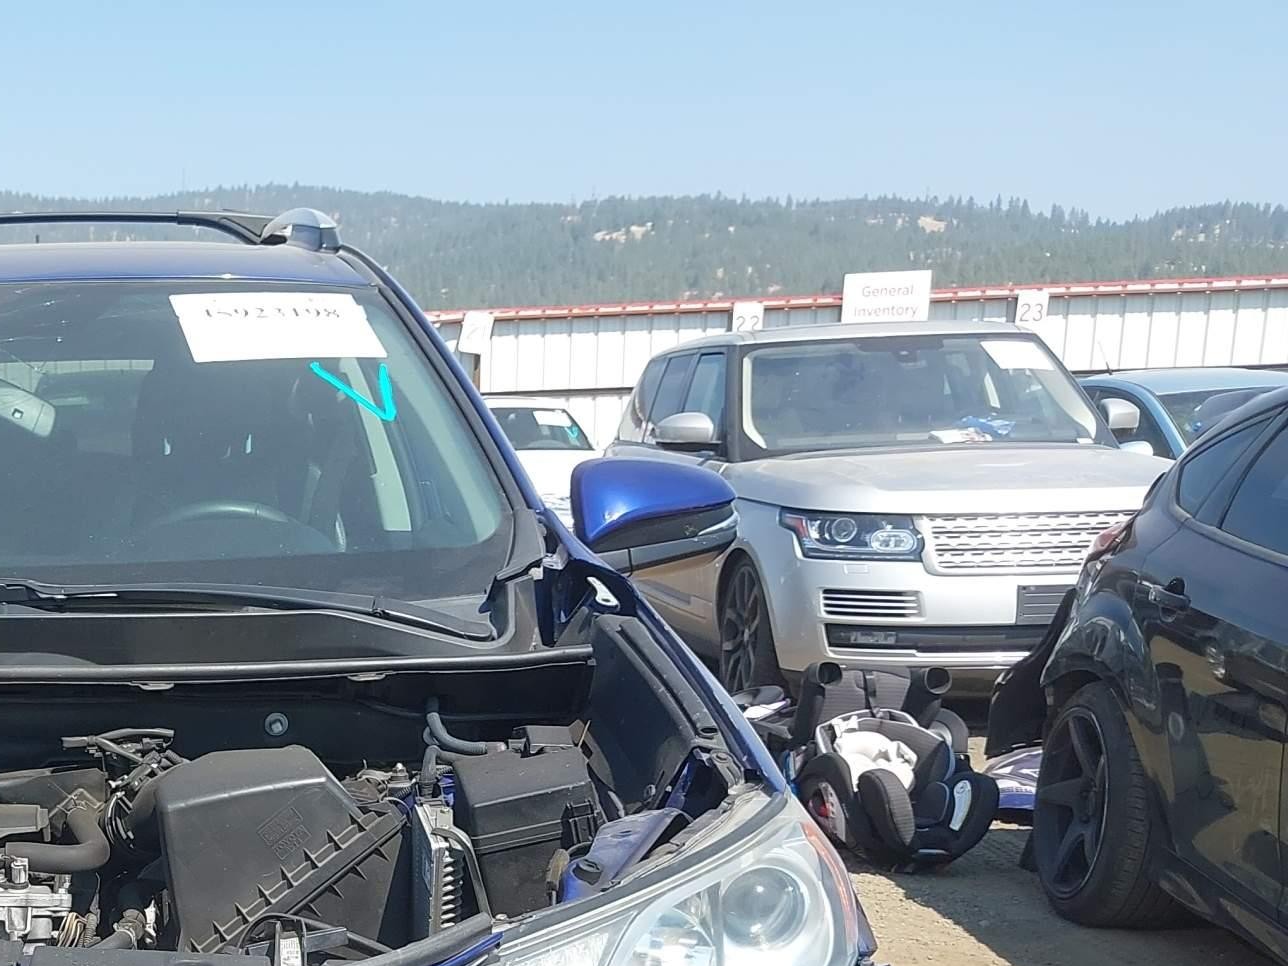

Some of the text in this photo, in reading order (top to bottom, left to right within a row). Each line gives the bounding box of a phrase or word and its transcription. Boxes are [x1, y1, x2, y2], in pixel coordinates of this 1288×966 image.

[862, 284, 914, 298] General
[854, 304, 919, 318] Inventory
[1020, 303, 1043, 322] 23
[736, 315, 760, 332] 22
